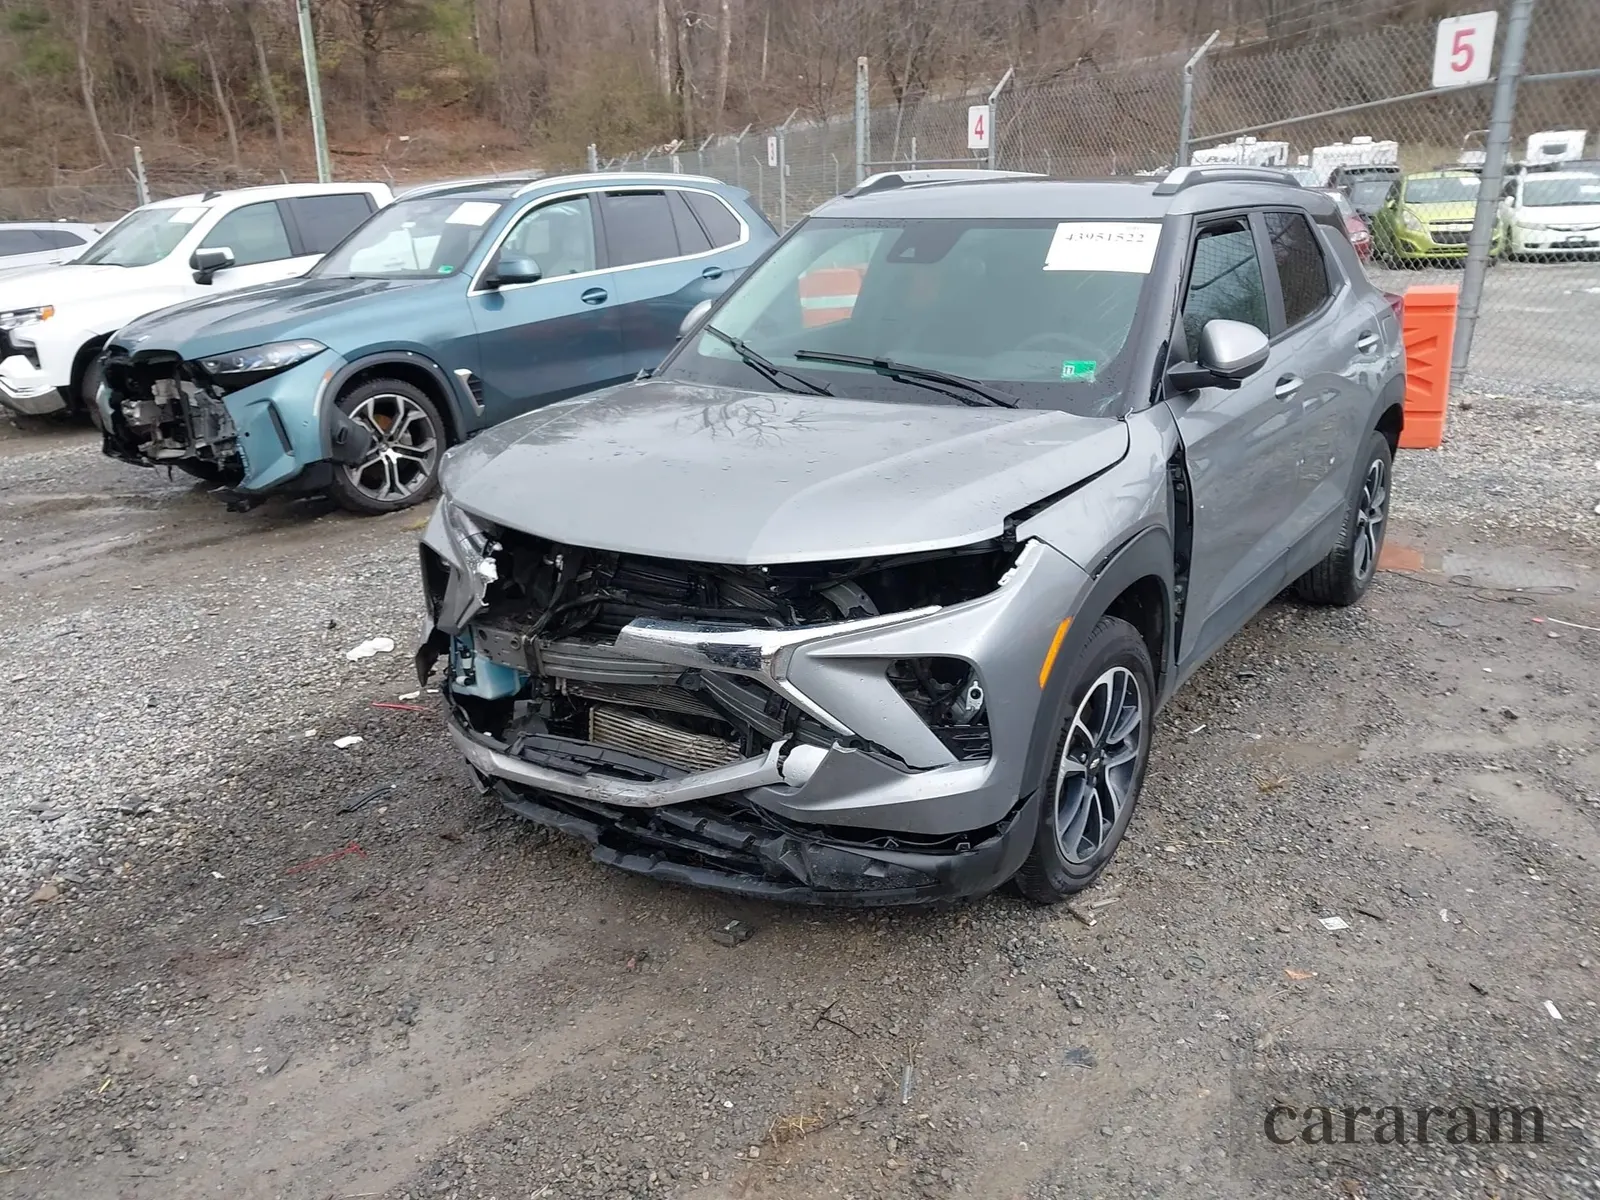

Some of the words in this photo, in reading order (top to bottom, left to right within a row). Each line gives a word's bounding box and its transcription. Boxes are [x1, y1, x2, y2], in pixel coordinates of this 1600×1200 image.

[1451, 28, 1476, 72] 5
[974, 114, 984, 141] 4
[1065, 232, 1144, 243] 43951522
